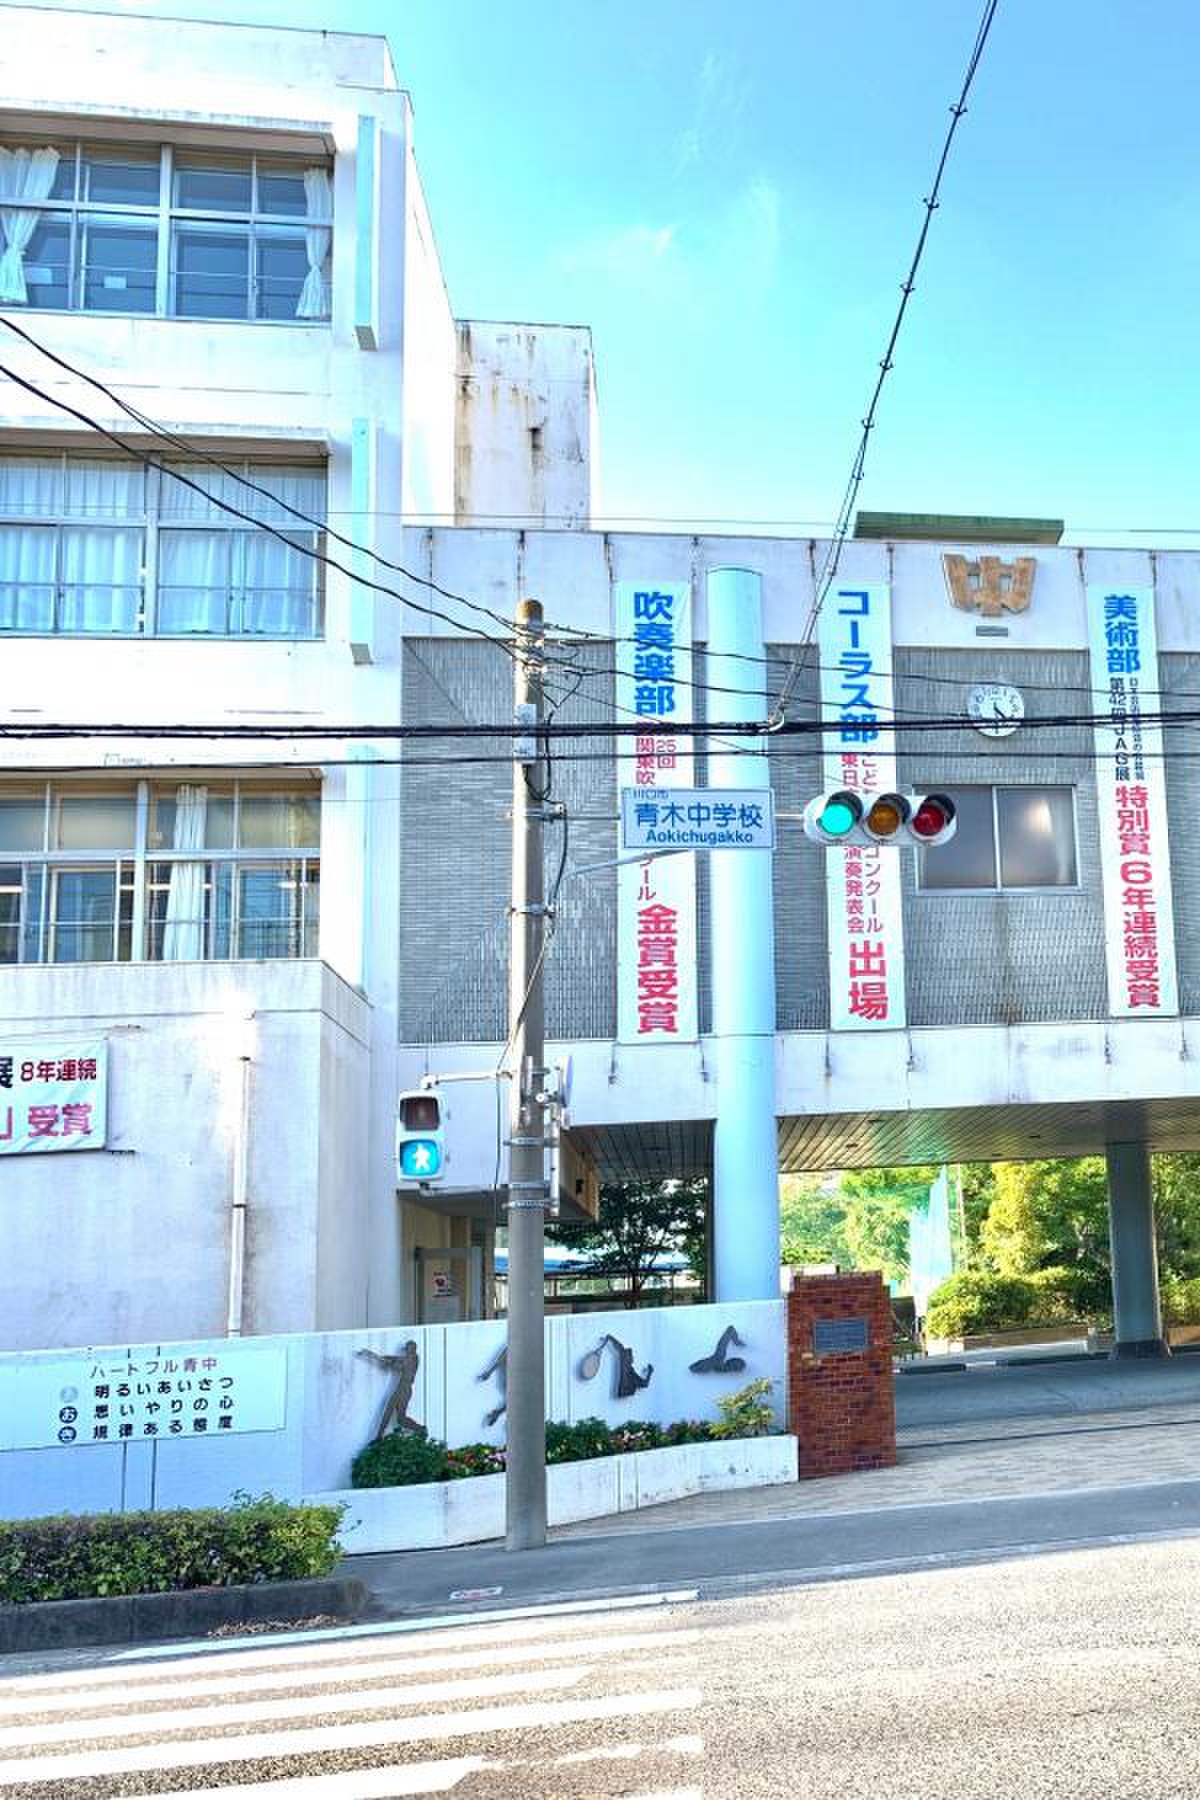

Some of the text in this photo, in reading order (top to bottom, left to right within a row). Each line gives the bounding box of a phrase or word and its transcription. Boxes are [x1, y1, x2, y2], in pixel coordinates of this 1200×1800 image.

[633, 591, 675, 716] 吹奏楽部
[1103, 594, 1141, 674] 美術部
[837, 590, 881, 744] コーラス部
[633, 802, 764, 829] 青木中学校
[645, 830, 753, 846] Aokichugakko
[1115, 786, 1161, 1009] 特別賞6年連続受賞
[637, 903, 679, 1034] 金賞受賞
[847, 940, 889, 1020] 出場
[20, 1058, 97, 1082] 8年連続
[90, 1357, 218, 1379] ハートフル青中
[95, 1376, 234, 1399] 明るいあいさつ
[93, 1395, 234, 1420] 思いやりの心
